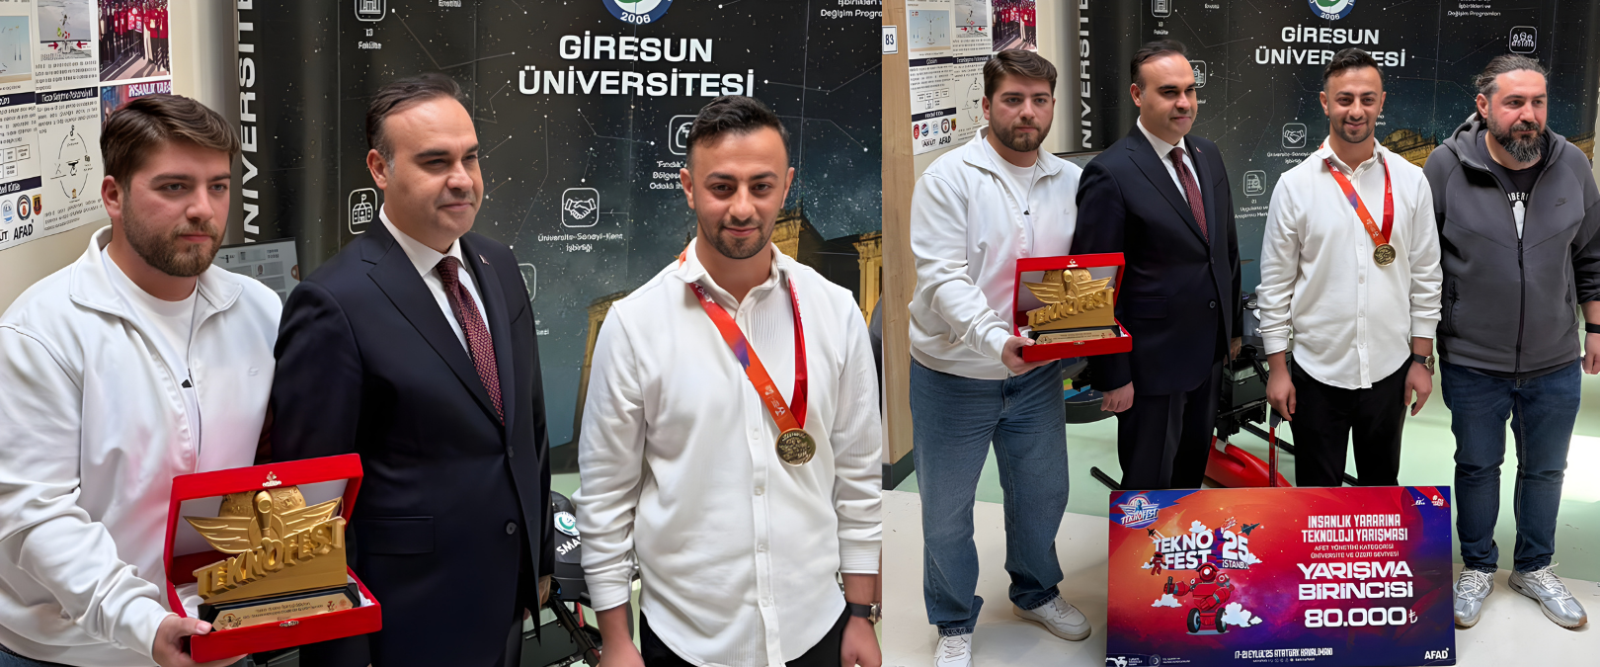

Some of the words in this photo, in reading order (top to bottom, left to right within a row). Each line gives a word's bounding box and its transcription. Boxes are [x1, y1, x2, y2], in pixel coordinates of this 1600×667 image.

[620, 11, 651, 25] 2006
[1320, 12, 1340, 21] 2006
[885, 33, 895, 46] 83
[1281, 23, 1380, 45] GİRESUN
[559, 30, 713, 63] GİRESUN
[1255, 45, 1406, 67] ÜNİVERESİ
[518, 65, 755, 98] ÜNİVERSİTESİ
[13, 221, 34, 241] AFAD
[1353, 513, 1401, 528] YARARINA
[556, 535, 582, 556] SMA
[1152, 530, 1214, 553] TEKNO
[1222, 530, 1250, 560] 25
[192, 515, 347, 600] TEKNOFEST
[1163, 549, 1213, 570] FEST
[1296, 561, 1413, 581] YARIŞMA
[1298, 581, 1414, 601] BİRİNCİSİ
[1424, 650, 1449, 660] AFAD
